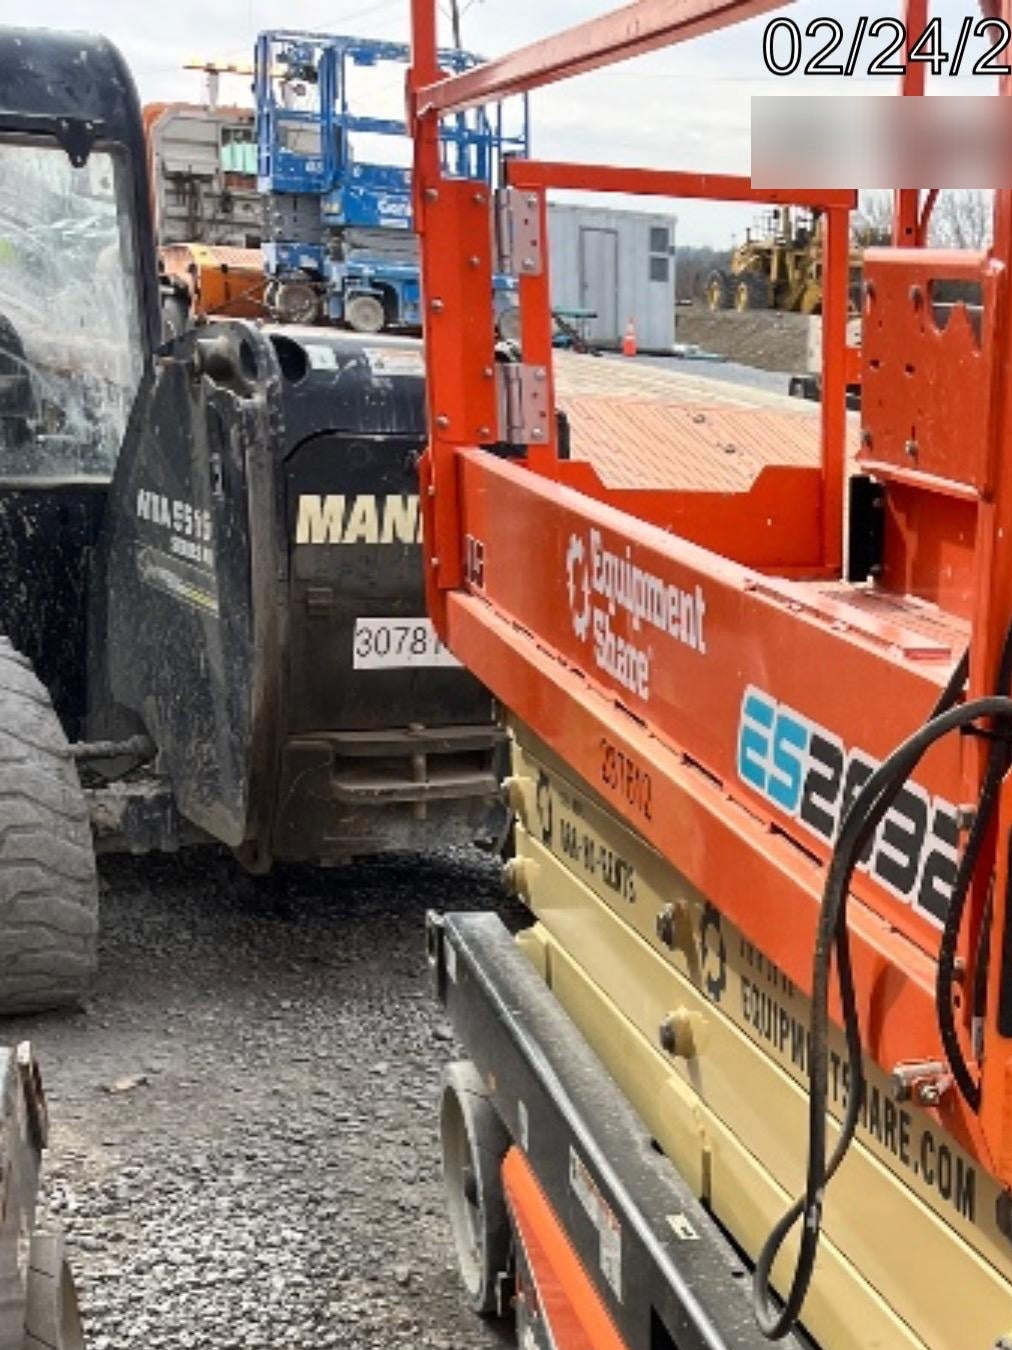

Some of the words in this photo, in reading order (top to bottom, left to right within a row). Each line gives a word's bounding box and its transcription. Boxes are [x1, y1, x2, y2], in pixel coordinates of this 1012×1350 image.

[296, 494, 424, 544] MAN
[590, 528, 707, 655] Equipment
[593, 606, 650, 701] Share
